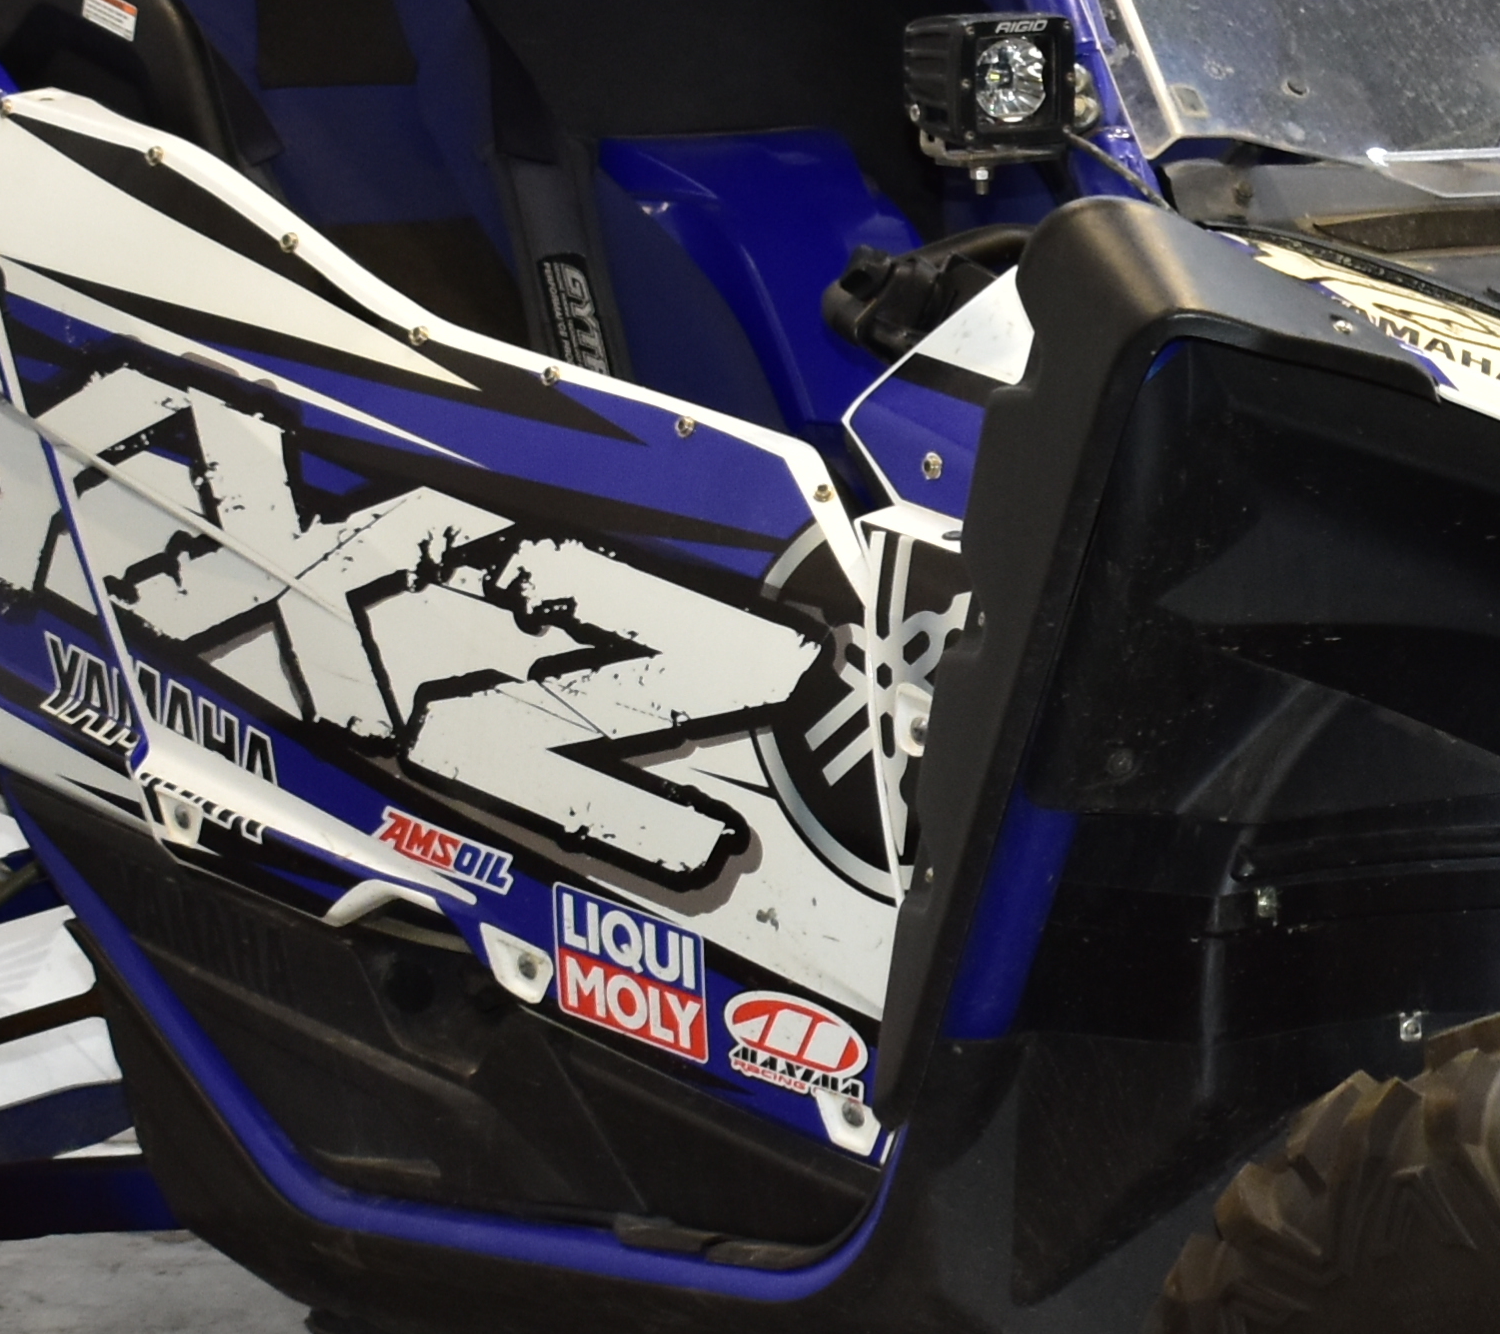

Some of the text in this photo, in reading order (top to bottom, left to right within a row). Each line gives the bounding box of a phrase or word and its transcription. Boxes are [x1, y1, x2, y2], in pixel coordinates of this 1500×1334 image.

[995, 19, 1049, 34] RIGID
[41, 631, 279, 844] YAMAHA
[374, 807, 514, 894] AMSOIL
[562, 892, 696, 990] LIQUI
[566, 957, 701, 1051] MOLY
[732, 1047, 861, 1100] MAXIMA
[733, 1060, 807, 1091] RACING
